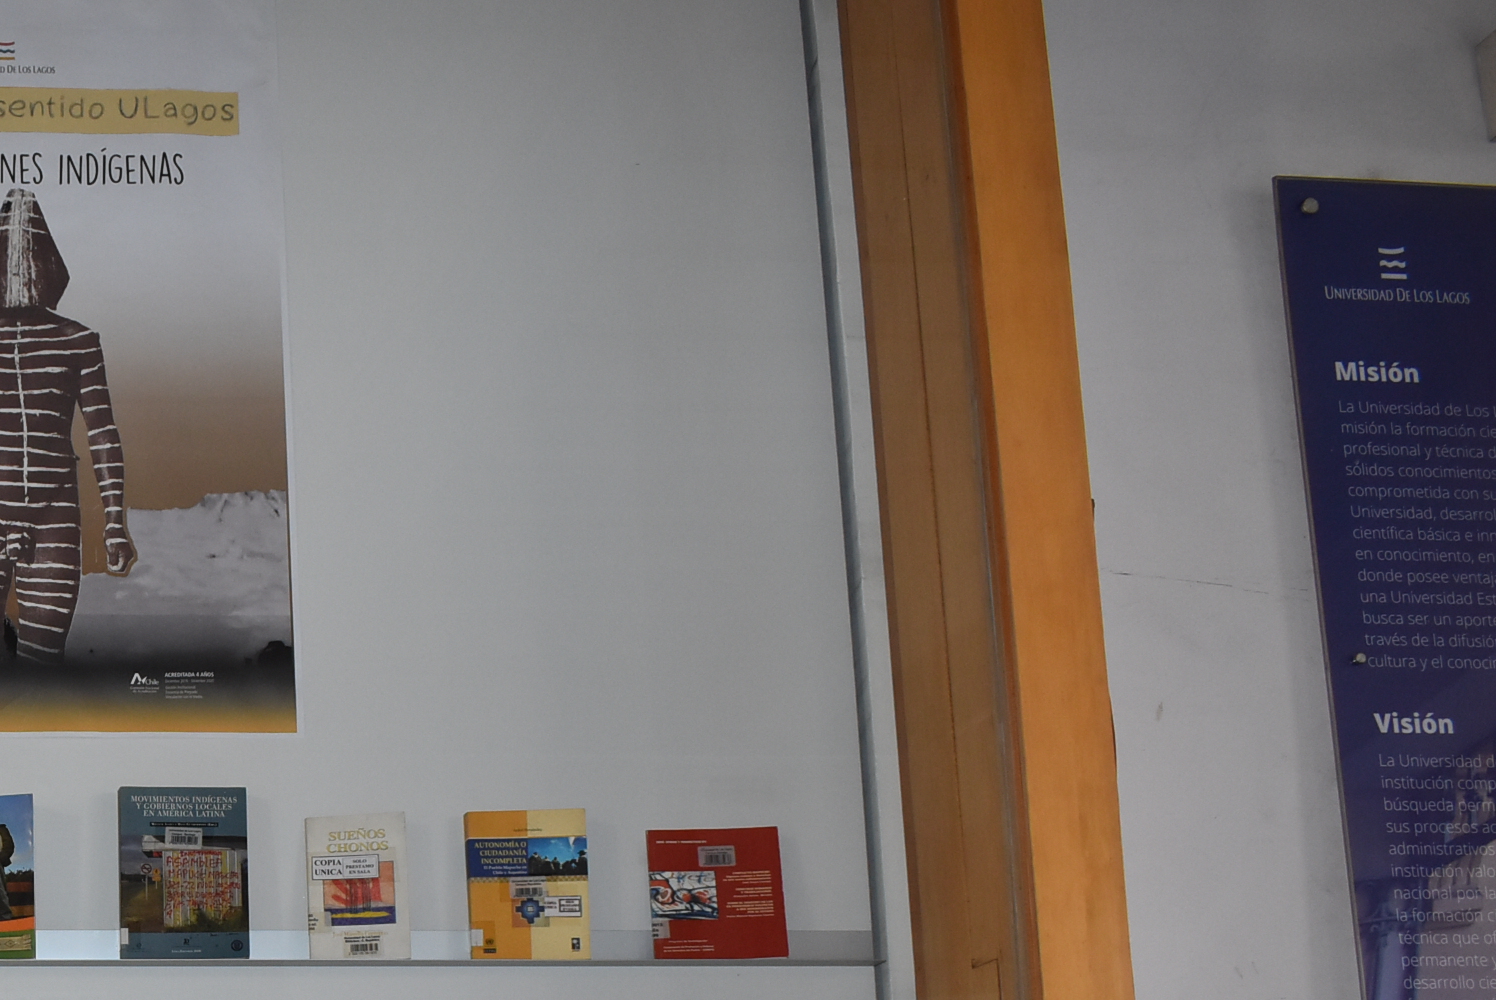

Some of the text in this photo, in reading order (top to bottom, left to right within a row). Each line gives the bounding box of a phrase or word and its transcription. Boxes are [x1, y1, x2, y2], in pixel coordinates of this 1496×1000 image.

[118, 96, 235, 126] ULagos
[58, 147, 185, 185] INDÍGENAS
[1335, 361, 1420, 383] Misión
[1339, 400, 1489, 417] La Universidad de Los
[1341, 421, 1475, 437] misión la formación
[1343, 442, 1484, 460] profesional y técnica
[1345, 461, 1496, 479] sólidos conocimientos
[1348, 486, 1478, 500] comprometida con
[1350, 505, 1436, 521] Universidad,
[1353, 526, 1473, 541] científica básica e
[1355, 549, 1495, 564] en conocimiento, en
[1358, 569, 1449, 585] donde posee
[1373, 712, 1454, 734] Visión
[192, 795, 237, 803] INDÍGENAS
[157, 809, 194, 817] AMÉRICA
[196, 810, 225, 818] LATINA
[328, 828, 386, 841] SUEÑOS
[326, 841, 389, 853] CHONOS
[474, 841, 520, 849] AUTONOMÍA
[480, 849, 526, 857] CIUDADANÍA
[314, 859, 342, 867] COPIA
